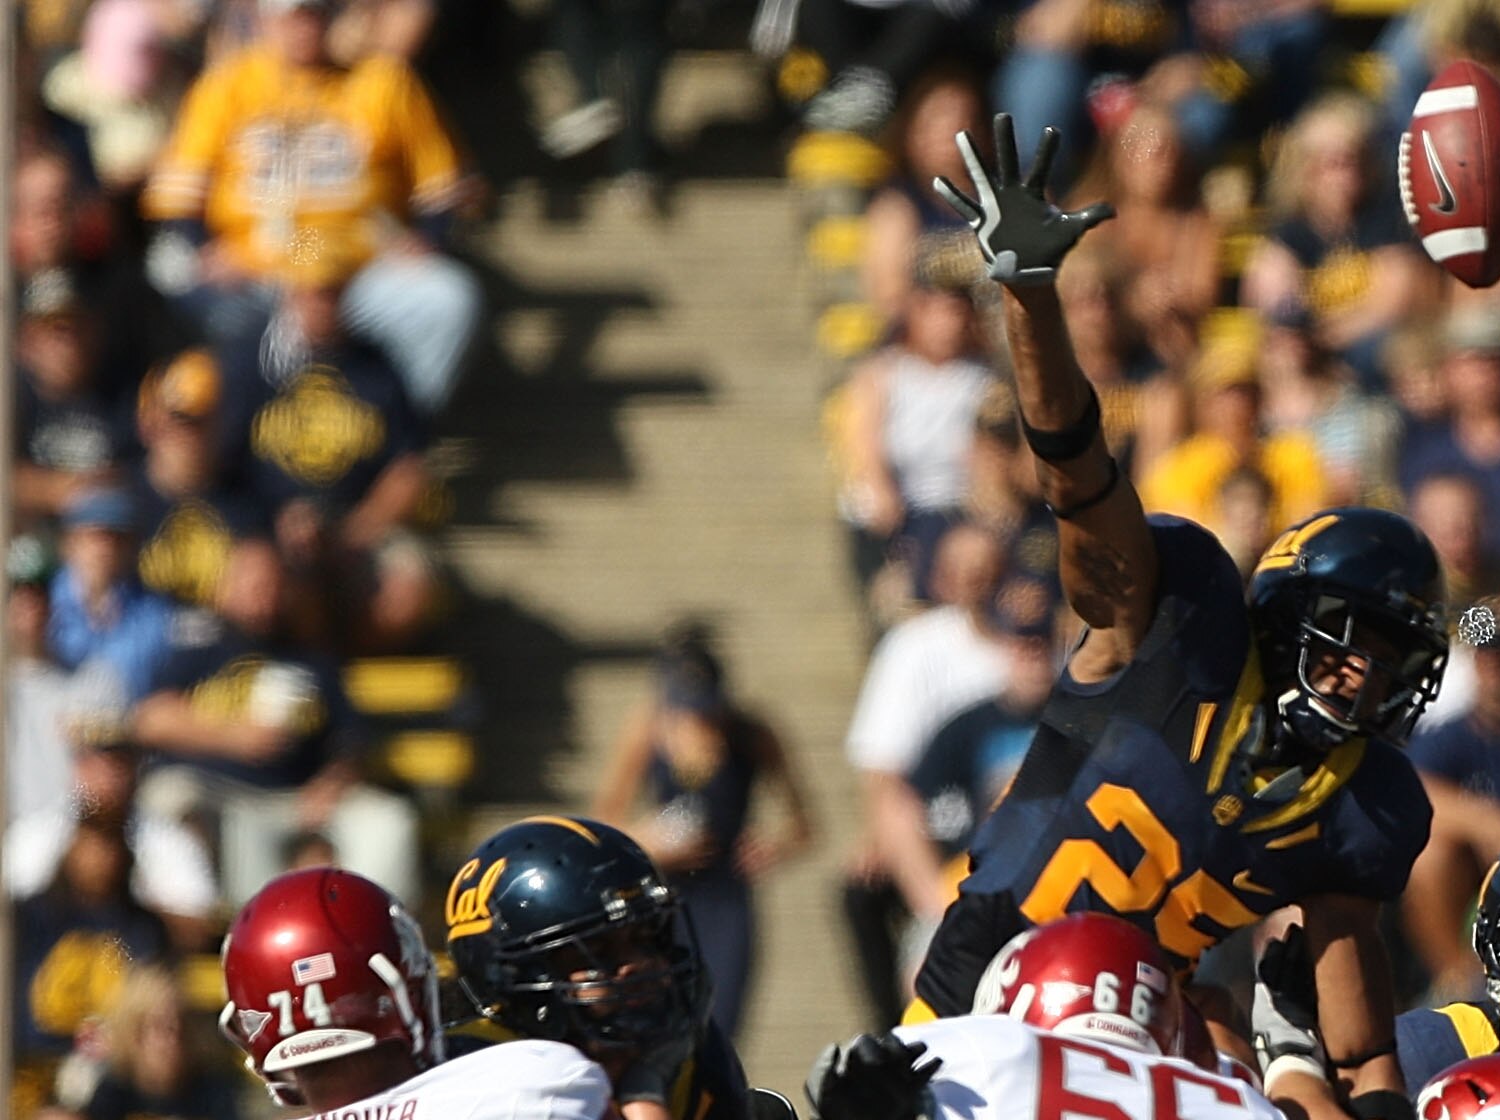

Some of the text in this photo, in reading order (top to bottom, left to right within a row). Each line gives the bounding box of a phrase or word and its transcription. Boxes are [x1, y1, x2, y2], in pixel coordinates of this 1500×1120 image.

[446, 857, 508, 942] Cal
[267, 982, 332, 1037] 74
[1092, 970, 1153, 1026] 66
